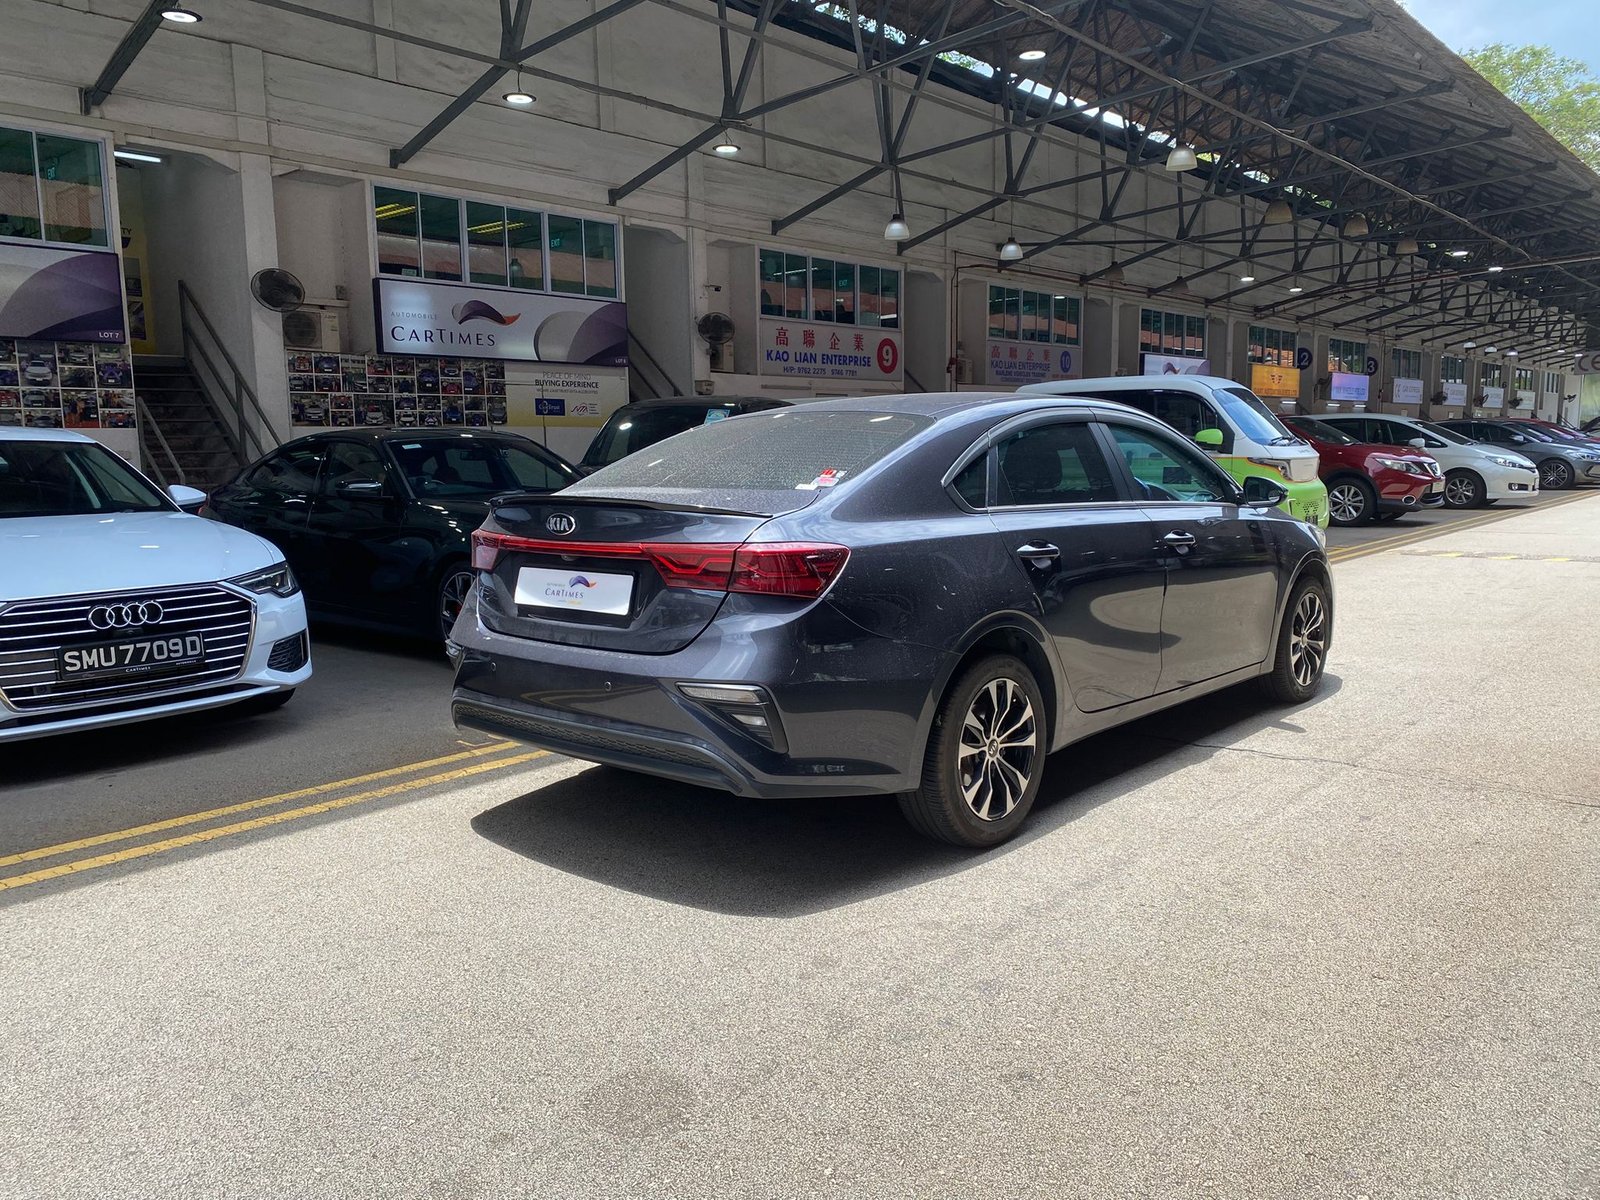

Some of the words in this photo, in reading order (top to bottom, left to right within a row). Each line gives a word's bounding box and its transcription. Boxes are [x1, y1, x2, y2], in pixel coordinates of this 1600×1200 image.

[390, 311, 437, 321] AUTOMOBILE
[99, 331, 113, 339] LOT
[766, 349, 790, 363] KAO
[794, 351, 817, 364] LIAN
[821, 353, 872, 368] ENTERPRISE
[991, 360, 1003, 370] KAO
[1004, 360, 1018, 370] LIAN
[1018, 361, 1051, 372] ENTERPRISE
[542, 371, 563, 379] PEACE
[535, 379, 561, 387] BUYING
[549, 517, 570, 531] KIA
